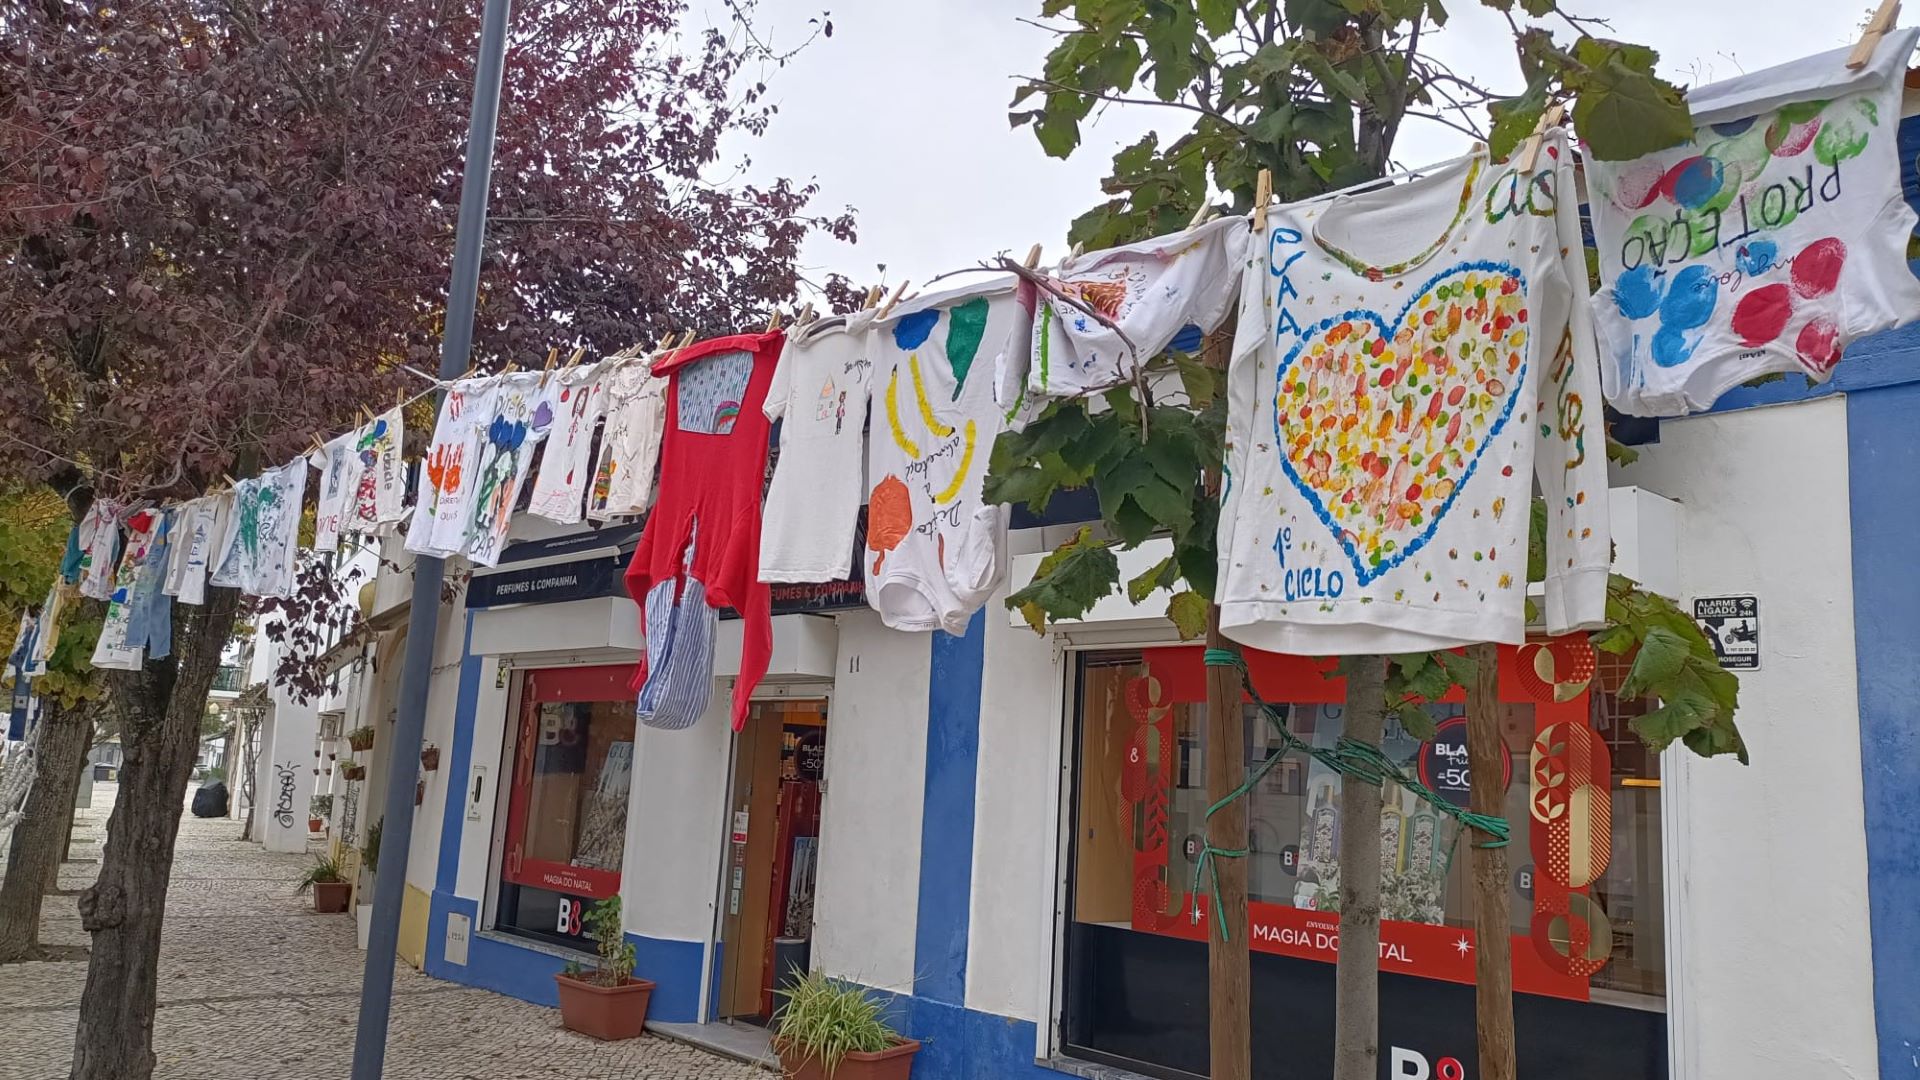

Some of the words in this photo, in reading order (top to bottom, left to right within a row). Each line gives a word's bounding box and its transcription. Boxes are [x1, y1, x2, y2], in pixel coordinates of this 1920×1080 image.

[496, 581, 530, 596] PERFUMES
[536, 575, 578, 591] COMPANHIA
[1284, 567, 1344, 602] CICLO
[1697, 607, 1738, 615] LIGADO
[1698, 599, 1738, 608] ALARME
[802, 744, 825, 753] BLAC
[1435, 743, 1468, 757] BLA
[543, 873, 563, 885] MAGIA
[563, 877, 573, 888] DO
[573, 880, 593, 892] NATAL
[1253, 923, 1312, 948] MAGIA
[1378, 942, 1413, 963] TAL
